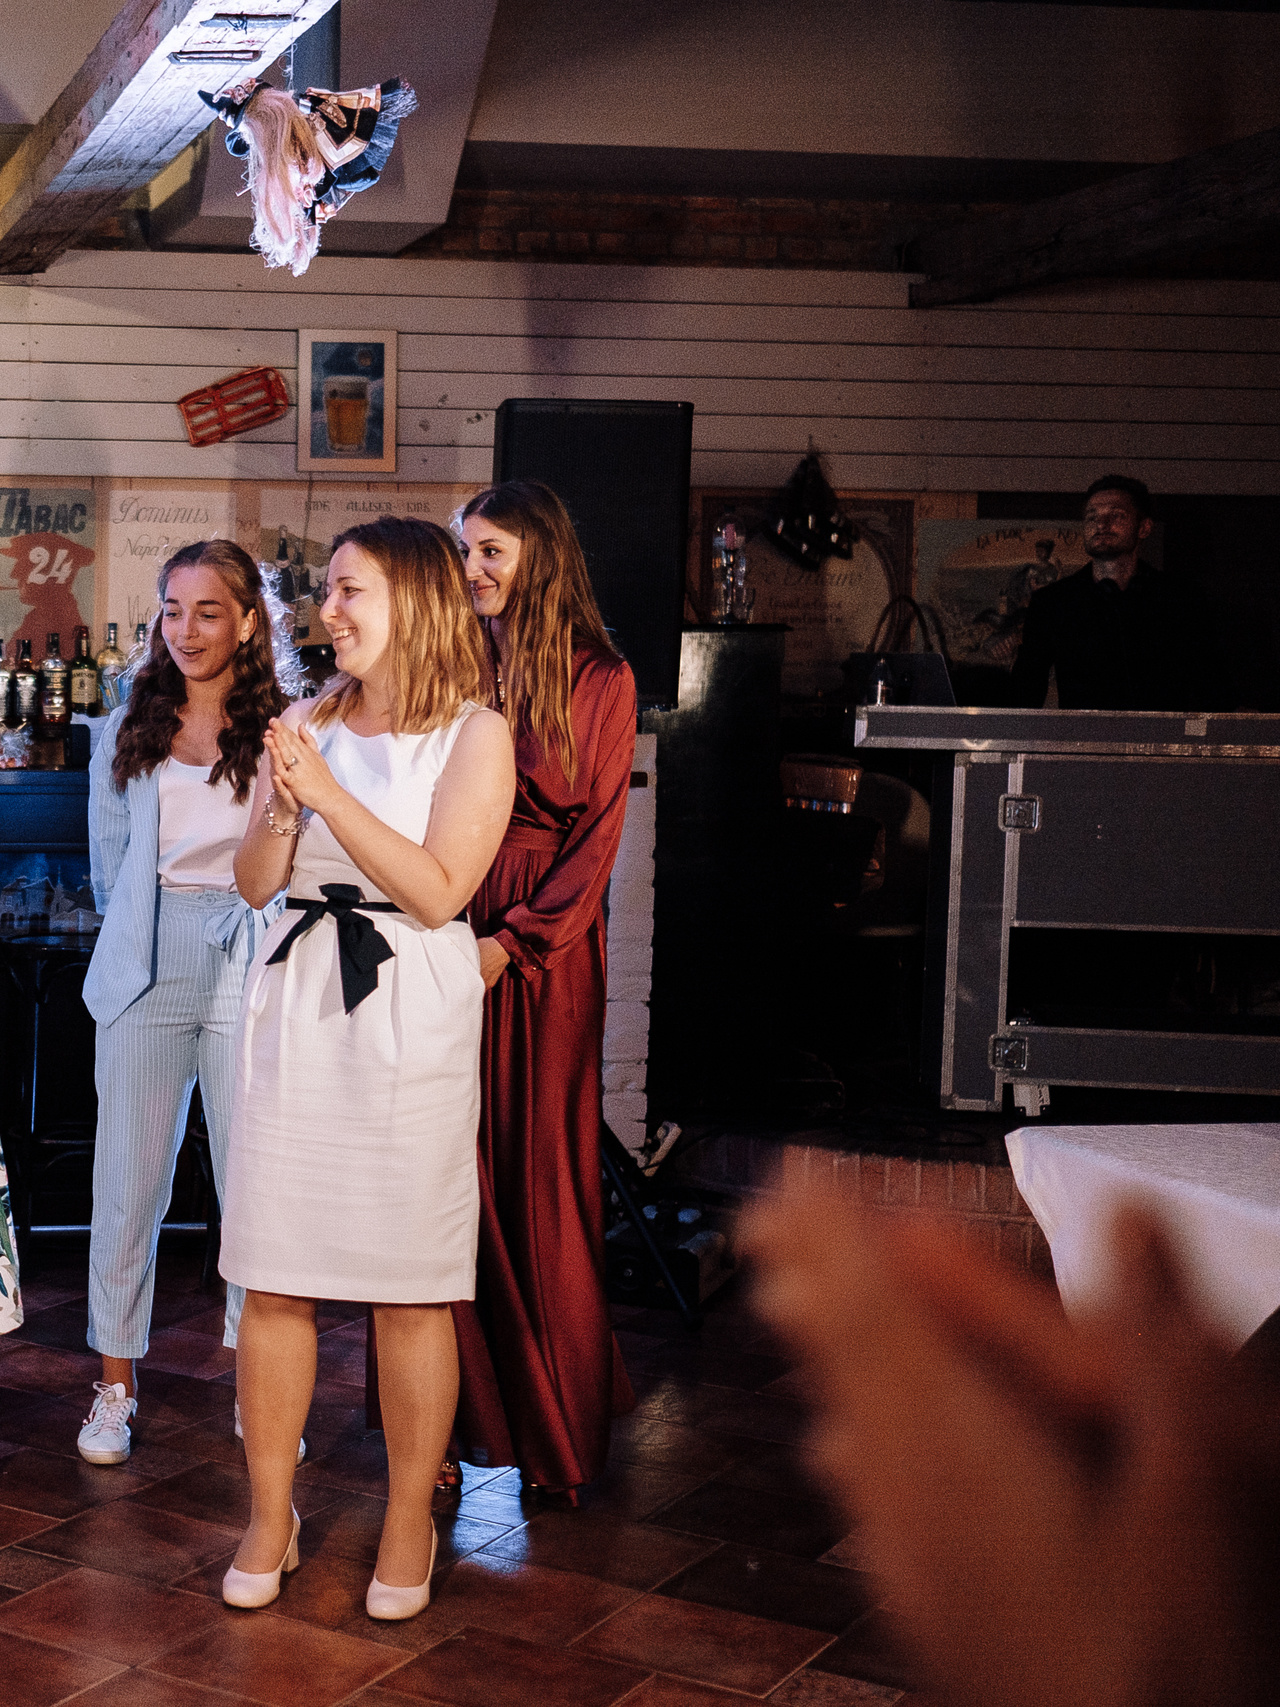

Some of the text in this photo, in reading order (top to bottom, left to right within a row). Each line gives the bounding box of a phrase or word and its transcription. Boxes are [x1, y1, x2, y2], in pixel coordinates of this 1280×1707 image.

[113, 496, 209, 524] Dominus
[114, 534, 160, 560] Napa
[27, 546, 74, 585] 24
